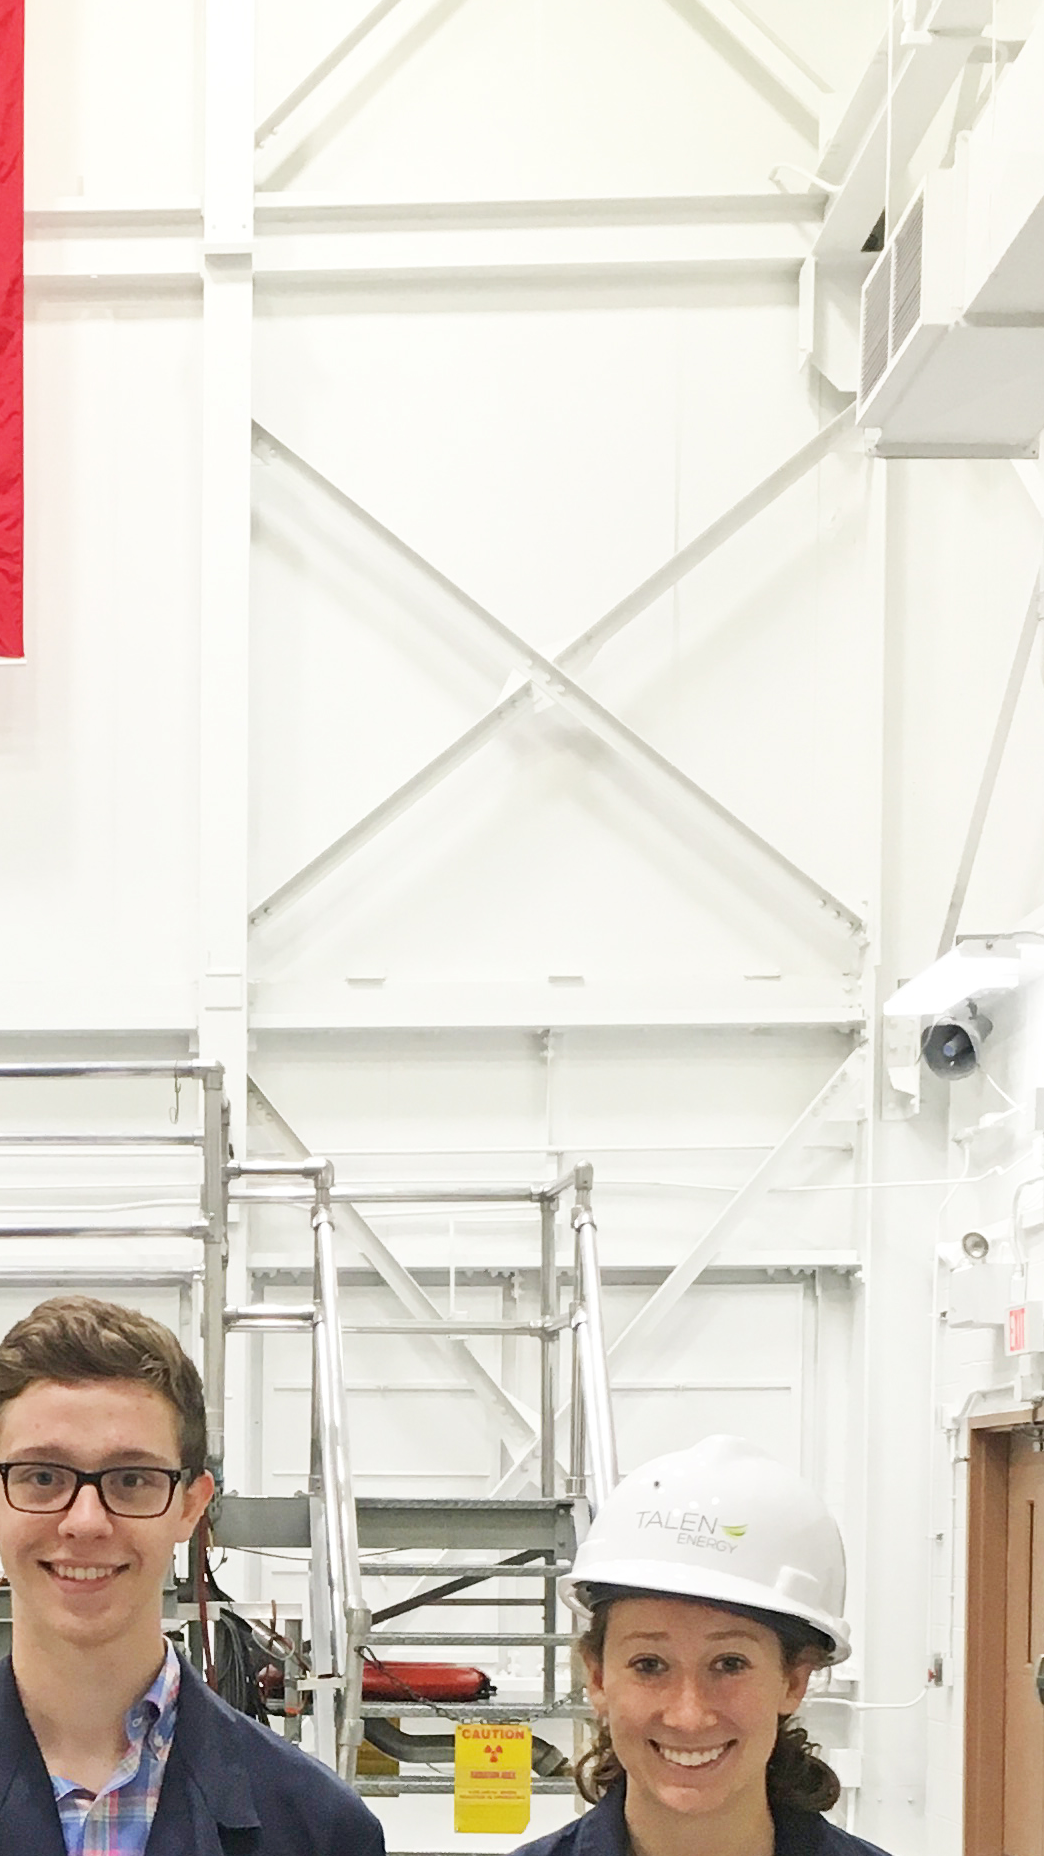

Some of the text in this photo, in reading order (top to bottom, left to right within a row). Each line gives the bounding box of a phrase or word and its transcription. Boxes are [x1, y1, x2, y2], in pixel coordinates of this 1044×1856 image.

[636, 1511, 718, 1534] TALEN
[676, 1533, 738, 1553] ENERGY
[462, 1729, 524, 1739] CAUTION
